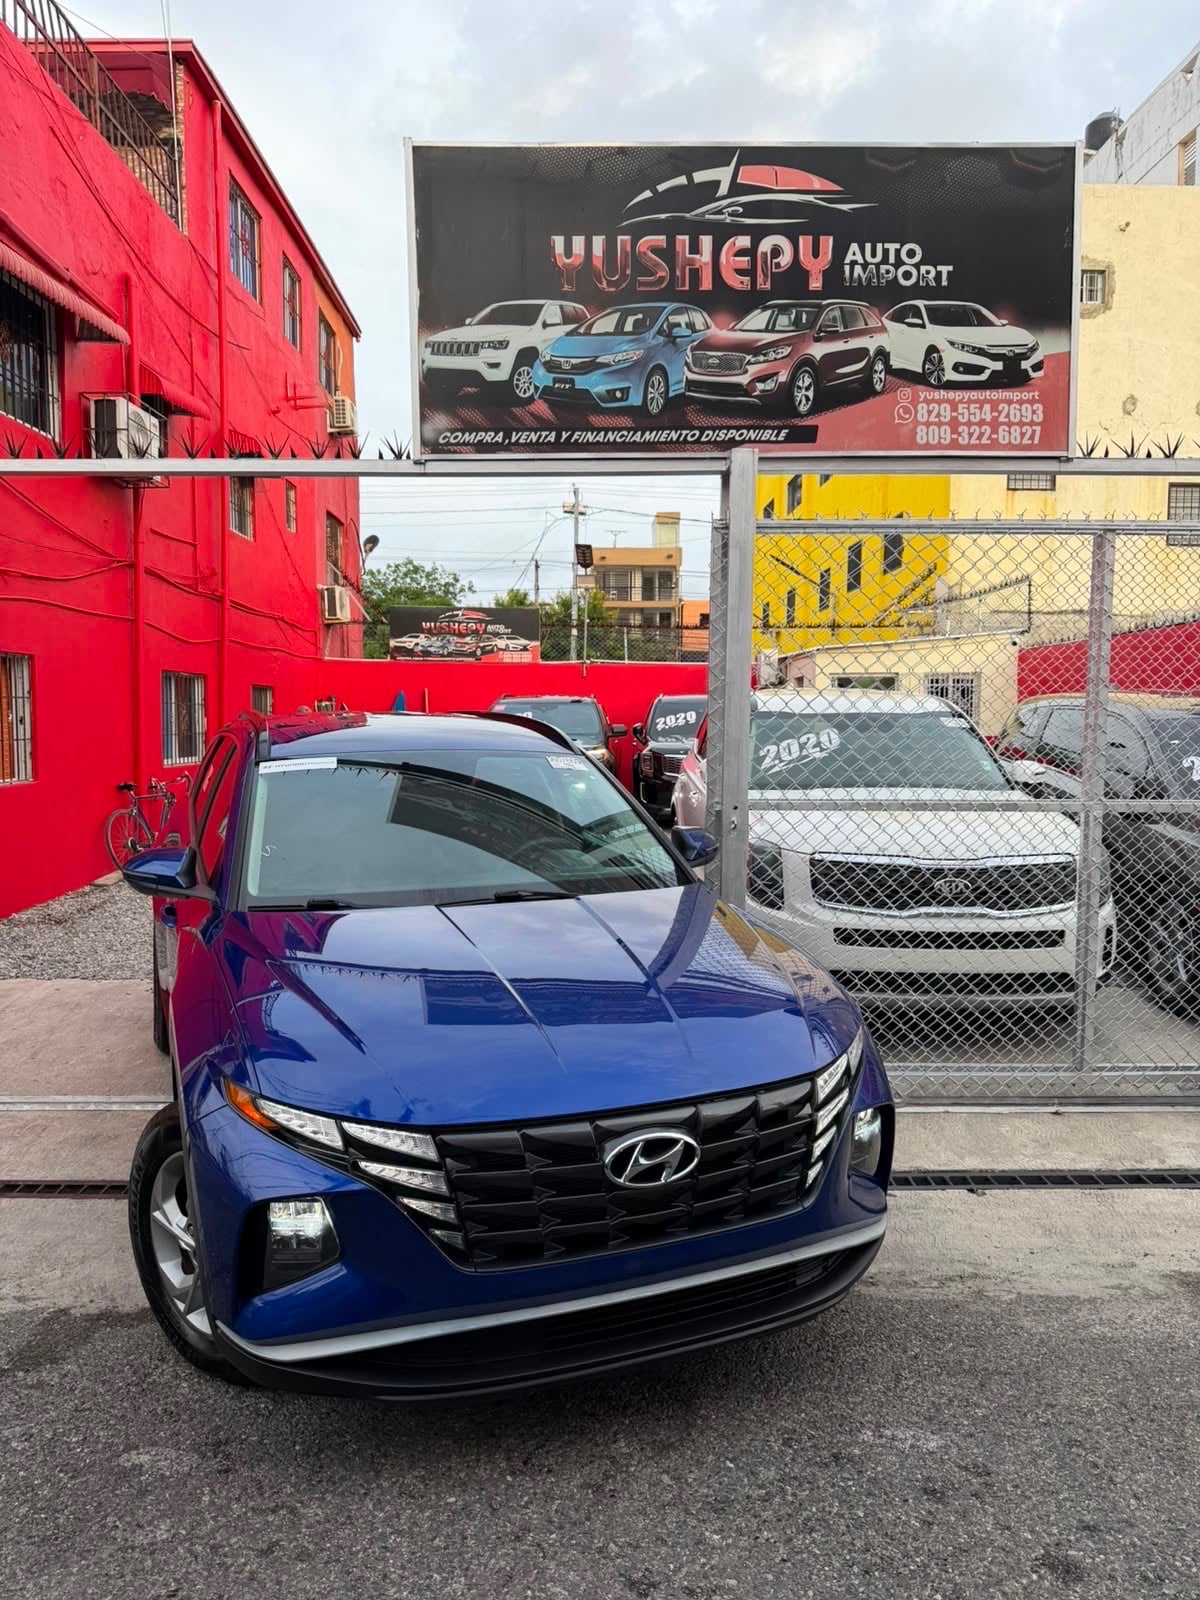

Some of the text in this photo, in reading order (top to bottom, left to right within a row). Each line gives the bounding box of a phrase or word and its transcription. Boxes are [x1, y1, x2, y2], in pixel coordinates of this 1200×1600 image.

[551, 235, 834, 292] YUSHEPY
[844, 242, 923, 265] AUTO
[843, 264, 953, 287] IMPORT
[918, 389, 1040, 402] yushepyautoimport
[916, 402, 1044, 423] 829-554-2693
[559, 431, 570, 443] Y
[570, 430, 700, 444] FINANCIAMIENTO
[700, 429, 789, 442] DISPONIBLE
[915, 425, 1042, 445] 809-322-6827
[655, 710, 697, 731] 2020
[759, 727, 841, 771] 2020
